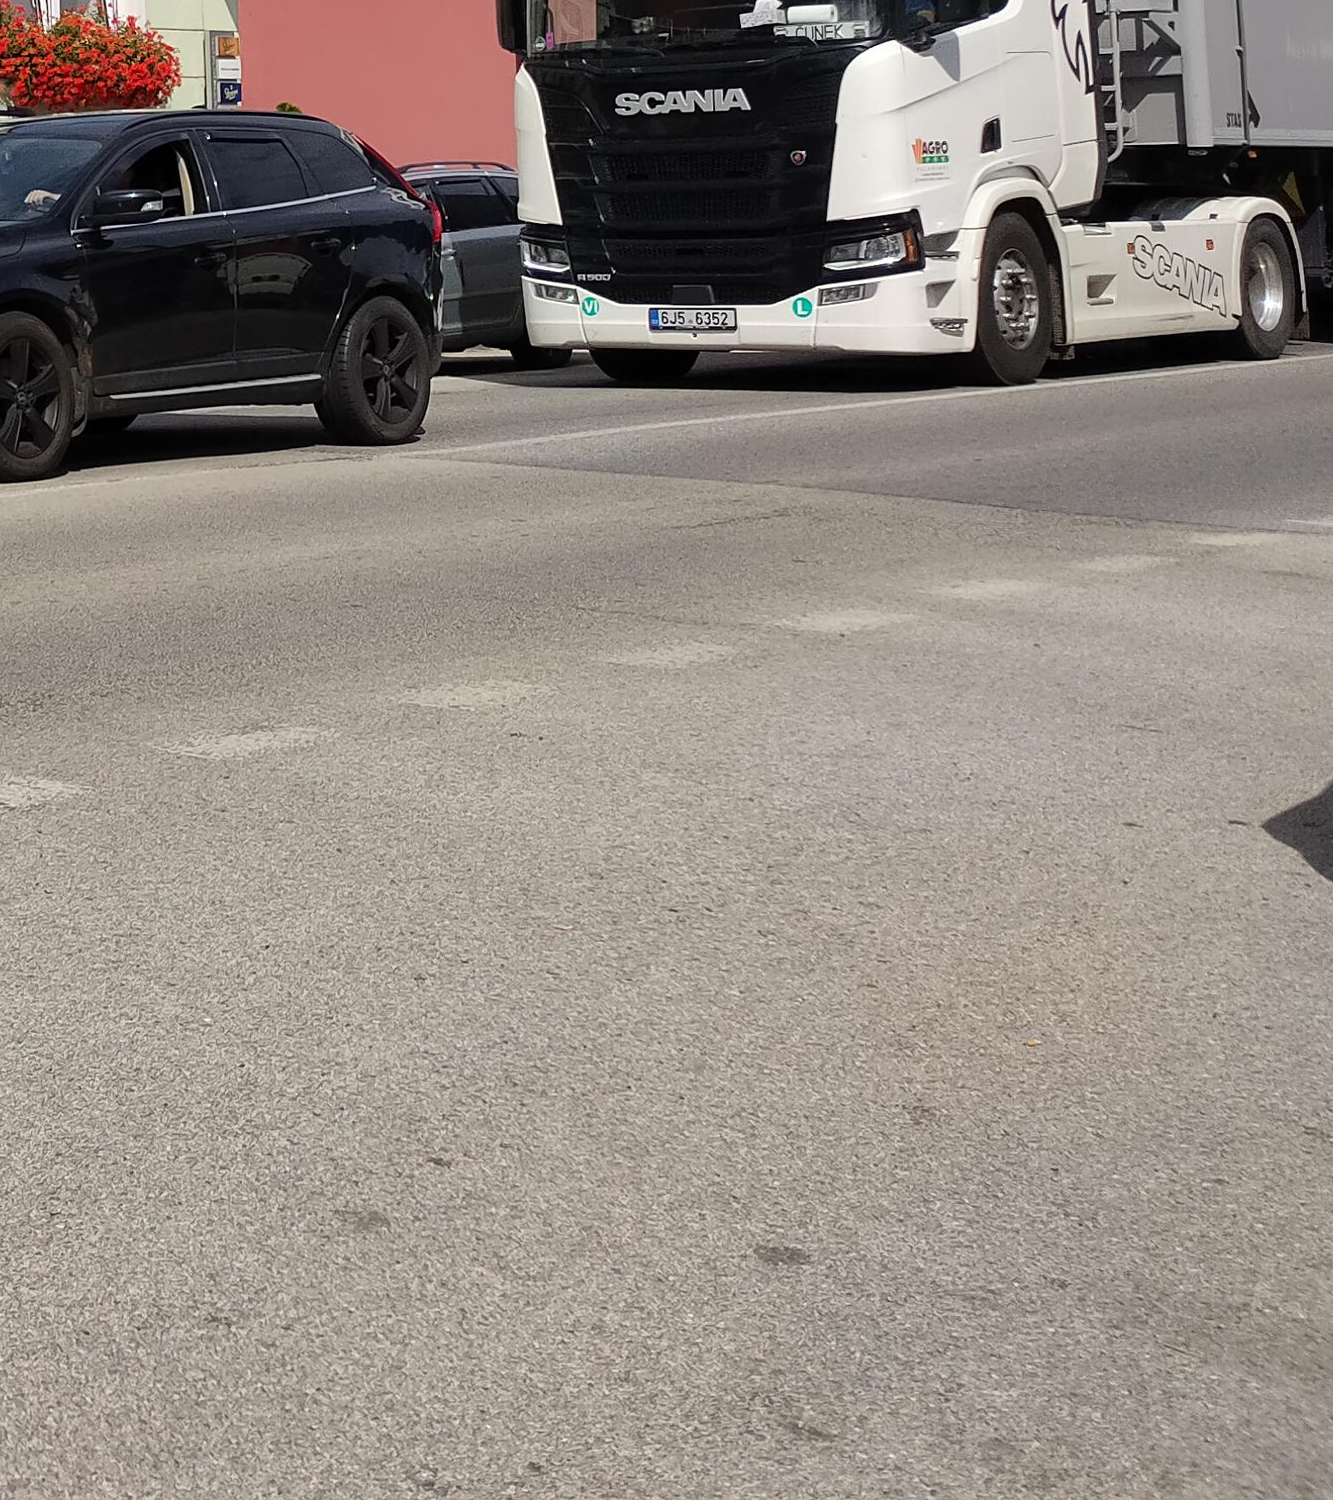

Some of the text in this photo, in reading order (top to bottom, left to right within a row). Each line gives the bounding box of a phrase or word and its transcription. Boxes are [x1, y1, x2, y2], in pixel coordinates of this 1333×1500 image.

[614, 88, 752, 116] SCANIA
[921, 140, 949, 155] AGRO
[1132, 234, 1227, 318] SCANIA
[797, 301, 809, 314] L
[661, 311, 686, 325] 6J5
[695, 311, 729, 326] 6352
